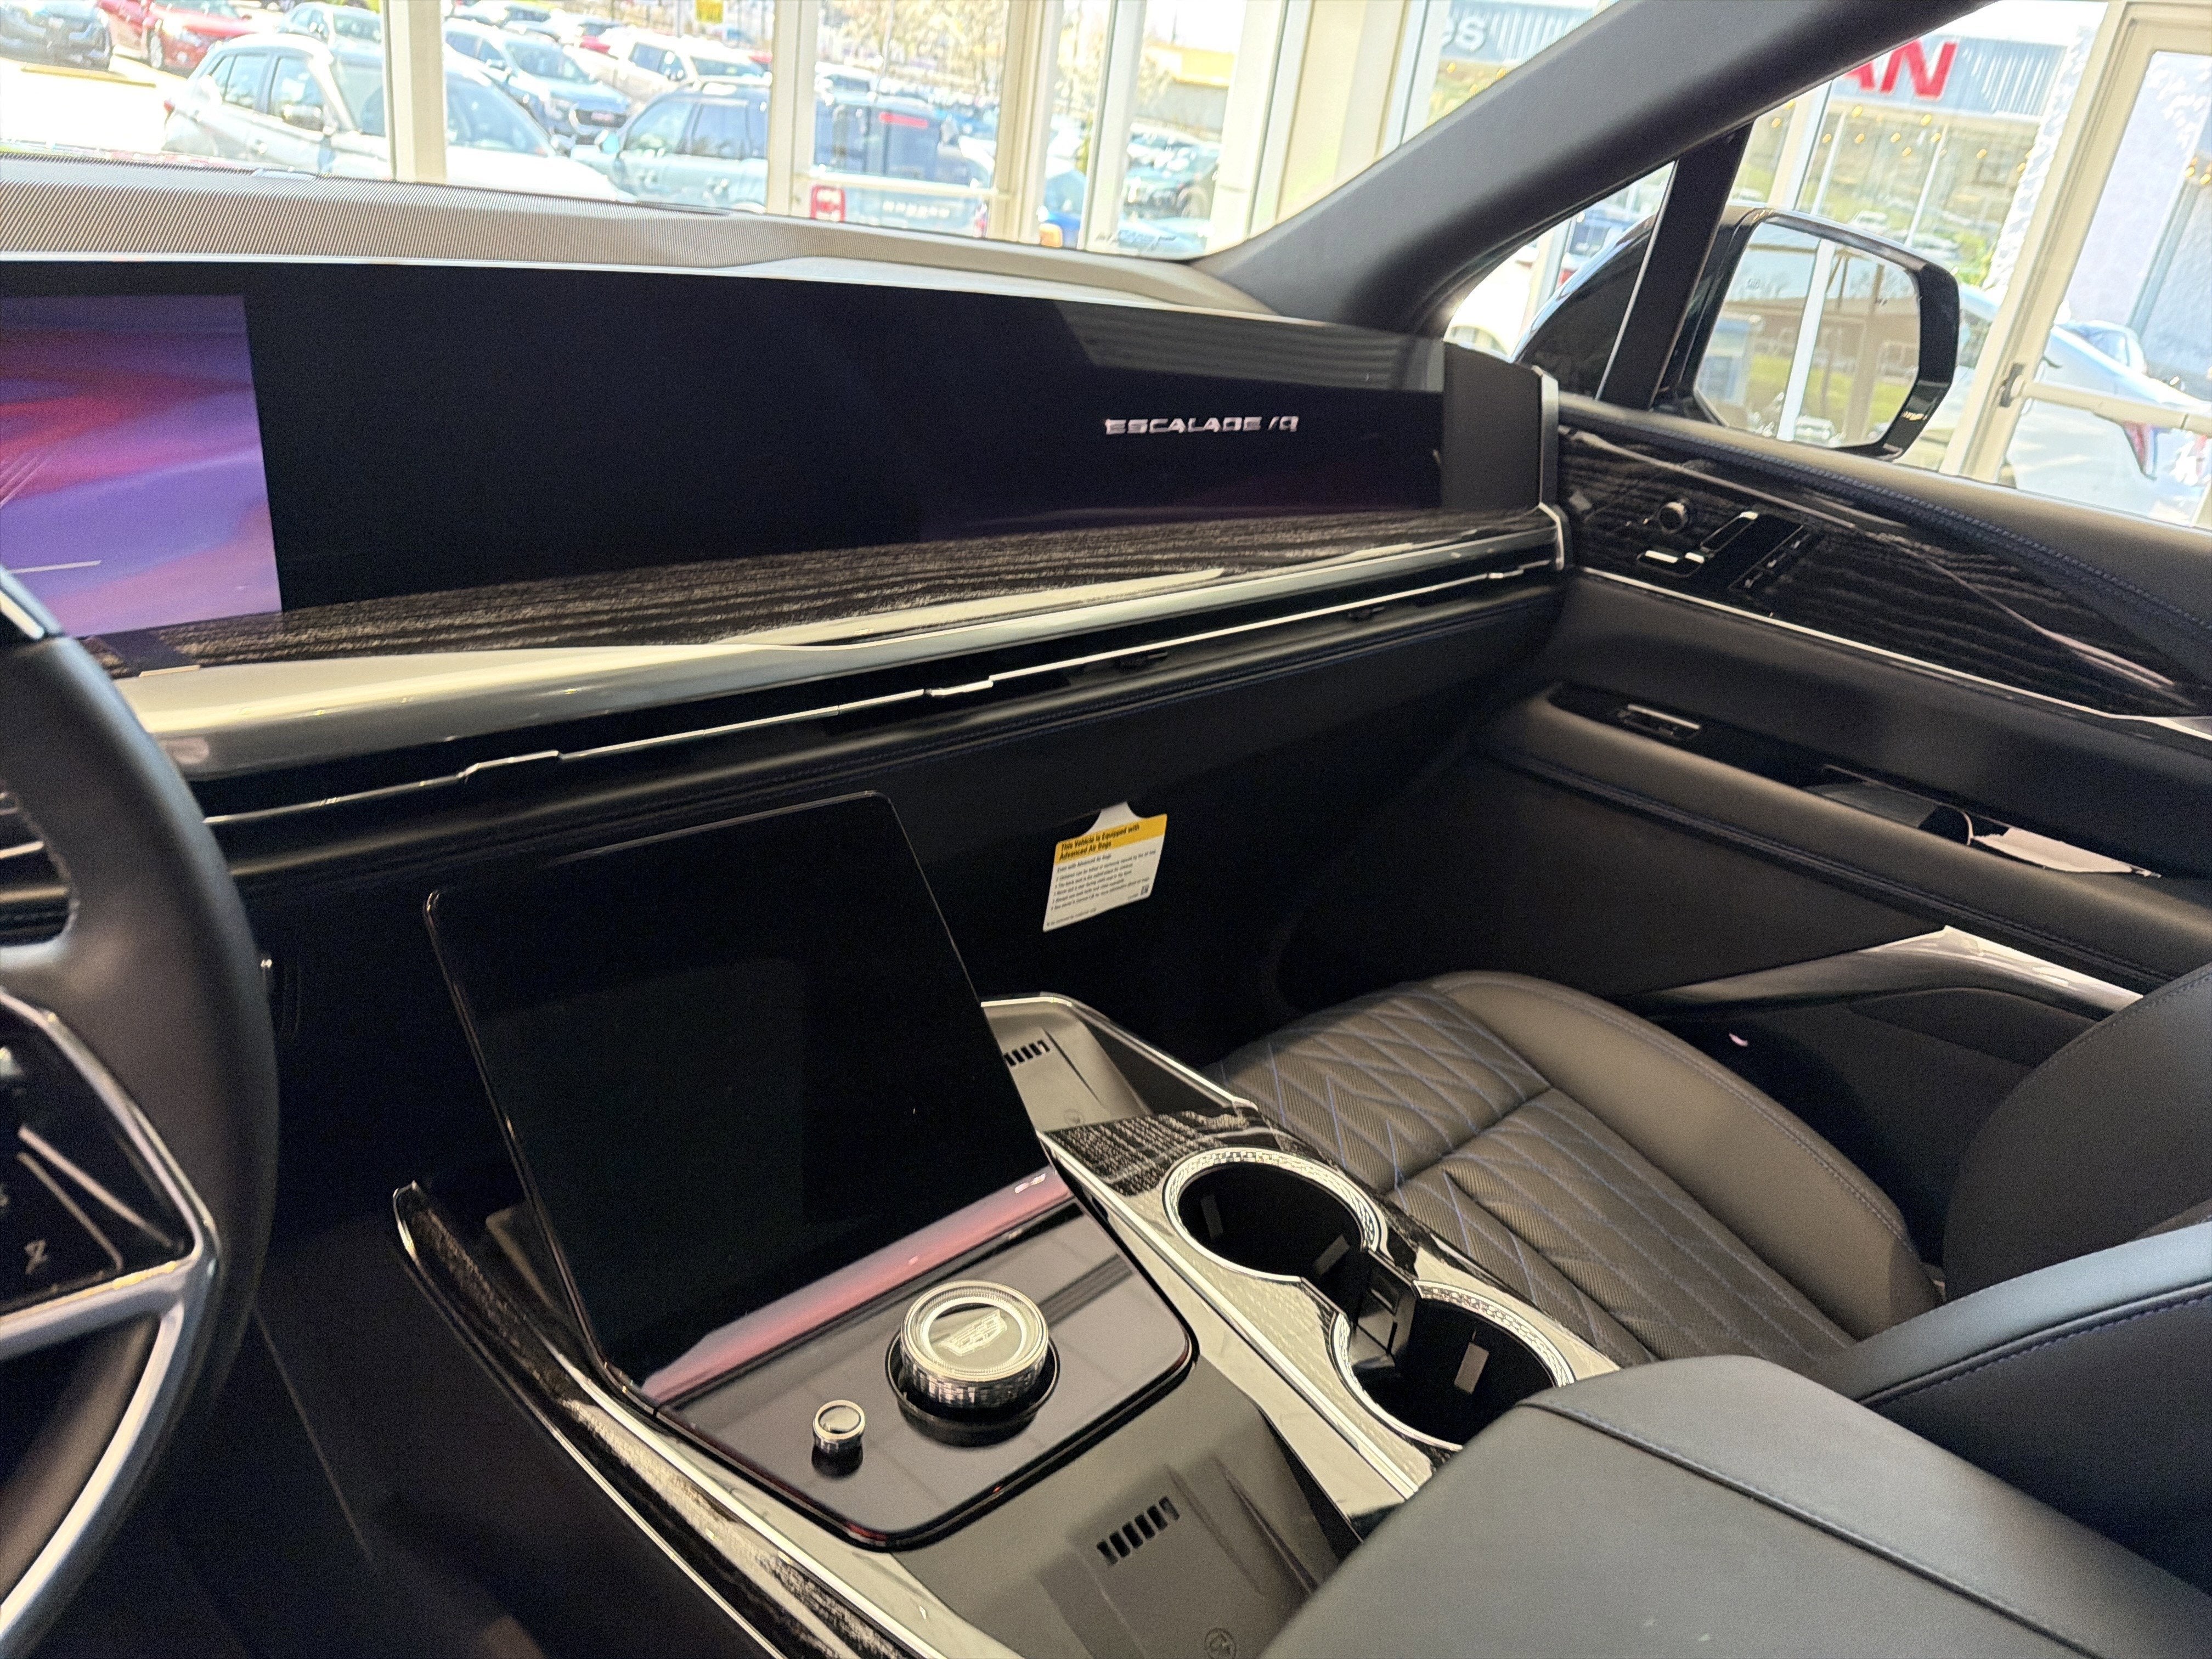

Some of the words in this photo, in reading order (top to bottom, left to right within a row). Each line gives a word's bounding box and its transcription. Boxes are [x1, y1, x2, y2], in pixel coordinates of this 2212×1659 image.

[1105, 417, 1262, 435] ESCALADE
[1062, 843, 1073, 851] This
[1075, 837, 1094, 848] Vehicle
[1102, 826, 1127, 840] Equipped
[1128, 823, 1140, 833] with
